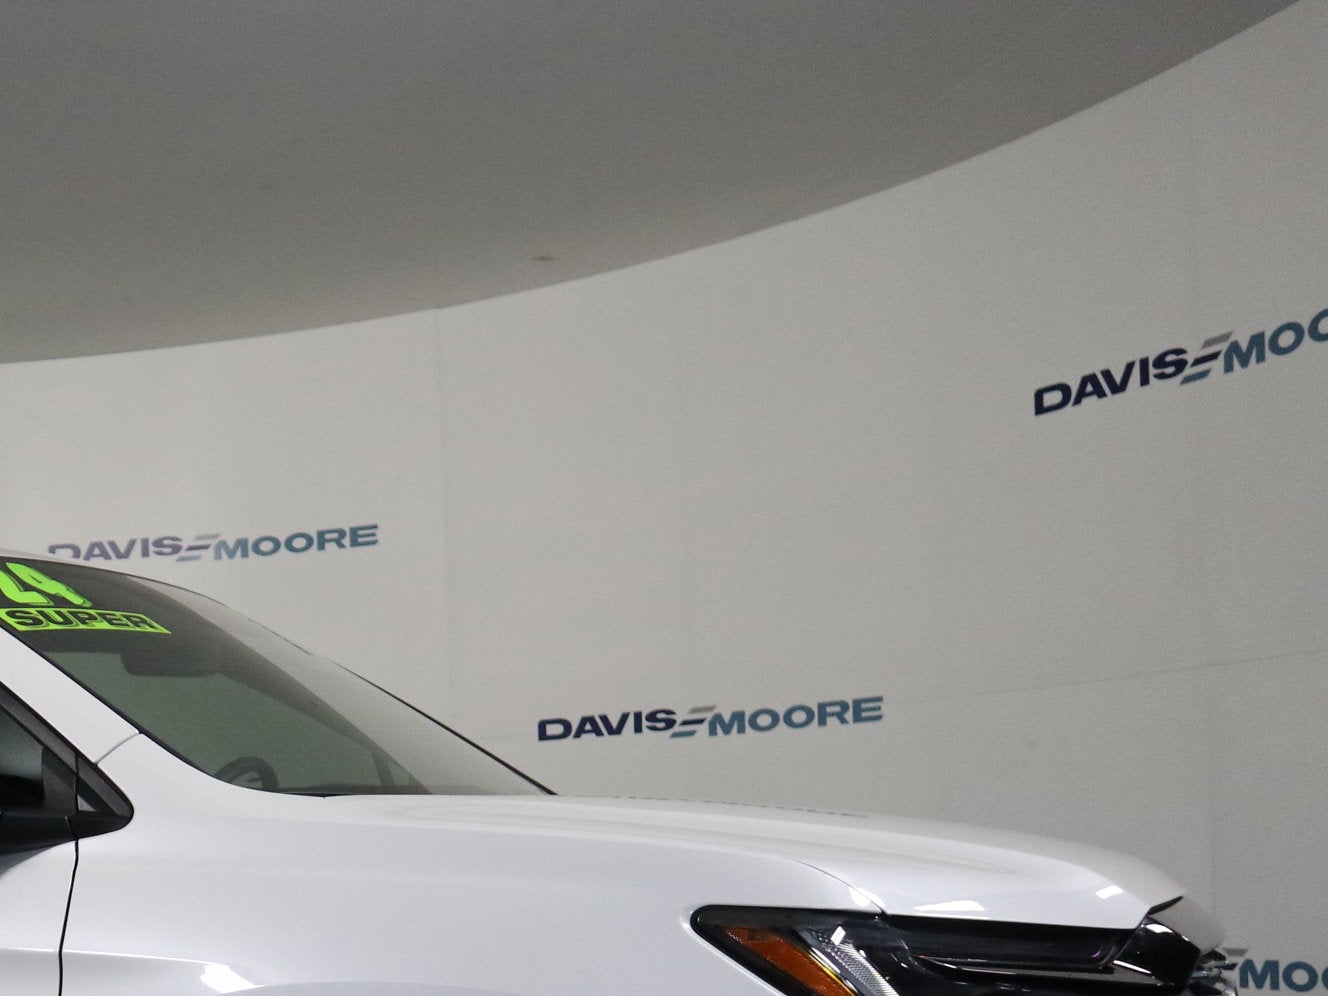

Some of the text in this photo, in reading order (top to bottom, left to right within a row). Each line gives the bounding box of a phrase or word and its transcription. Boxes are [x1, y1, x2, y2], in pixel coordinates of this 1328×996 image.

[1034, 347, 1189, 416] DAVIS
[213, 523, 378, 561] MOORE
[5, 609, 158, 629] SUPER
[538, 696, 884, 741] DAVIS MOORE
[1238, 958, 1328, 992] MO
